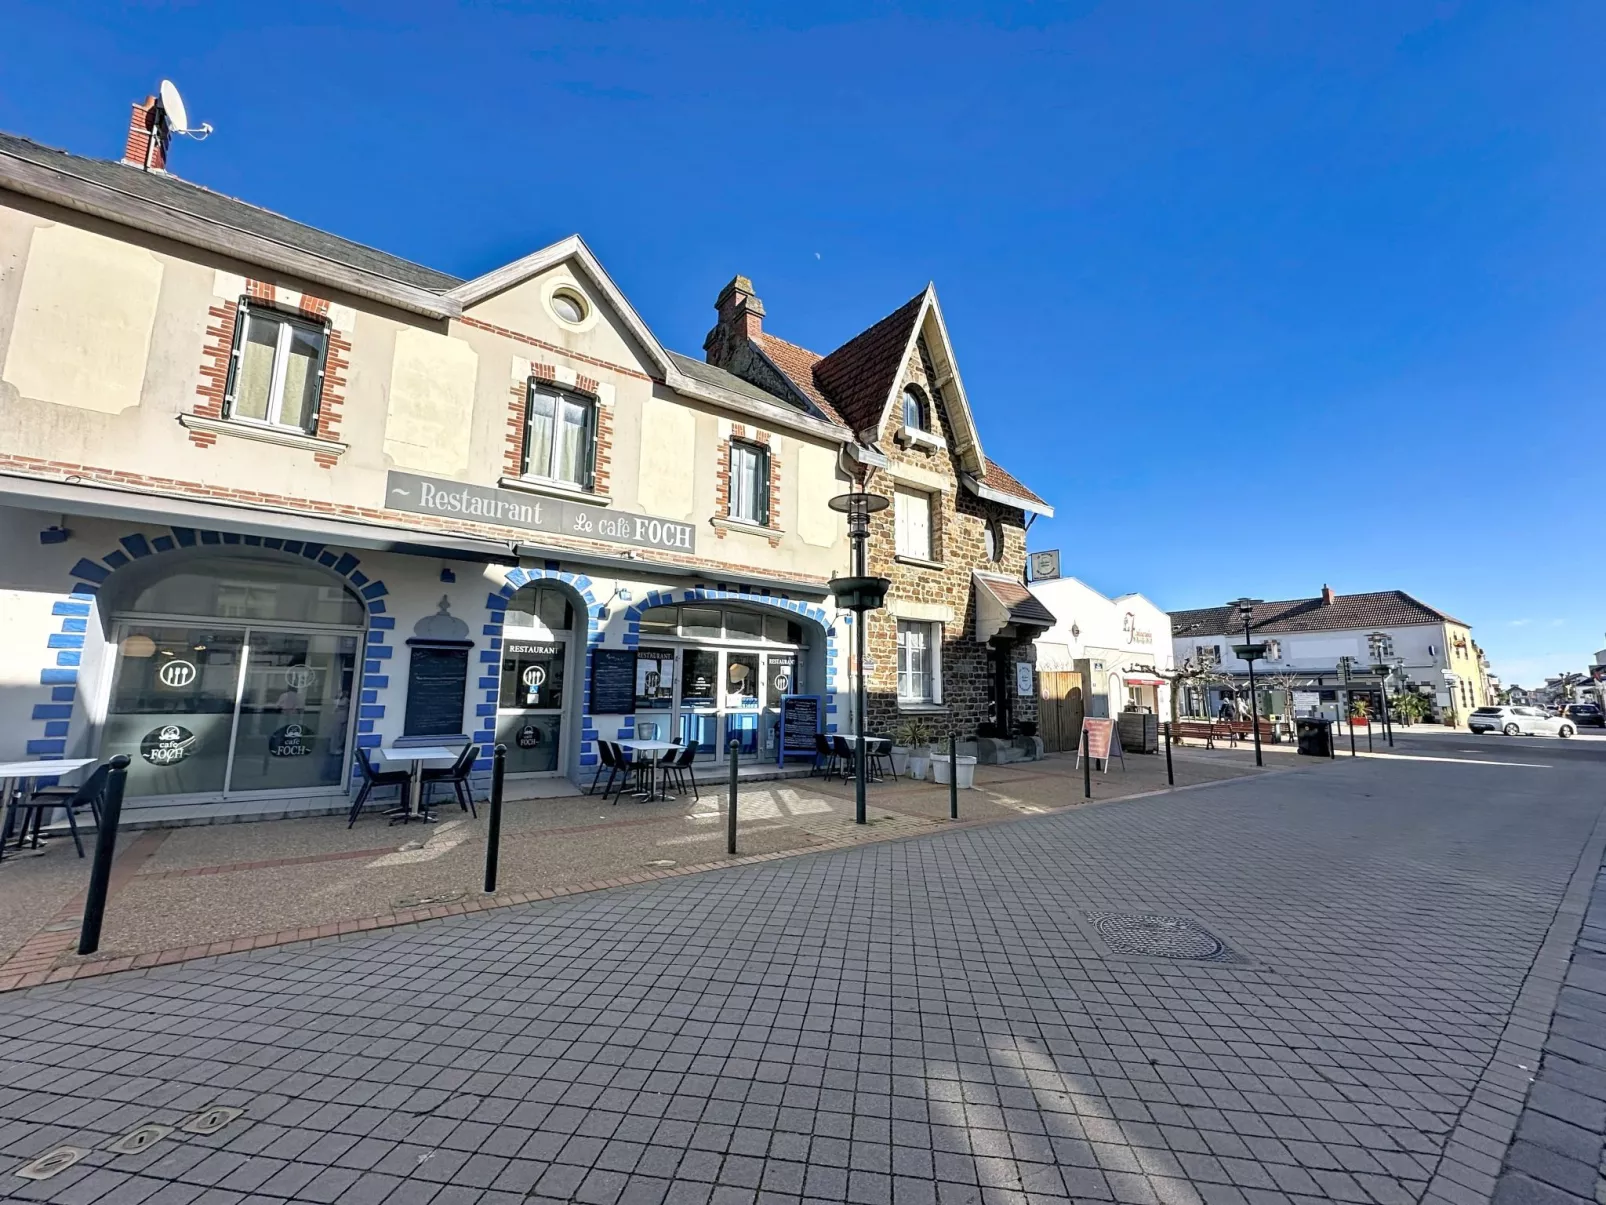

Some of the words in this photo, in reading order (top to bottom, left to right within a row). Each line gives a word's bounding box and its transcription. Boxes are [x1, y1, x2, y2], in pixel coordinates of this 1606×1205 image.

[419, 482, 544, 525] Restaurant
[573, 513, 593, 532] Le
[599, 517, 630, 538] café
[633, 517, 691, 549] FOCH
[509, 645, 559, 654] RESTAURANT
[150, 747, 184, 760] FOCH
[276, 745, 305, 755] FOCH
